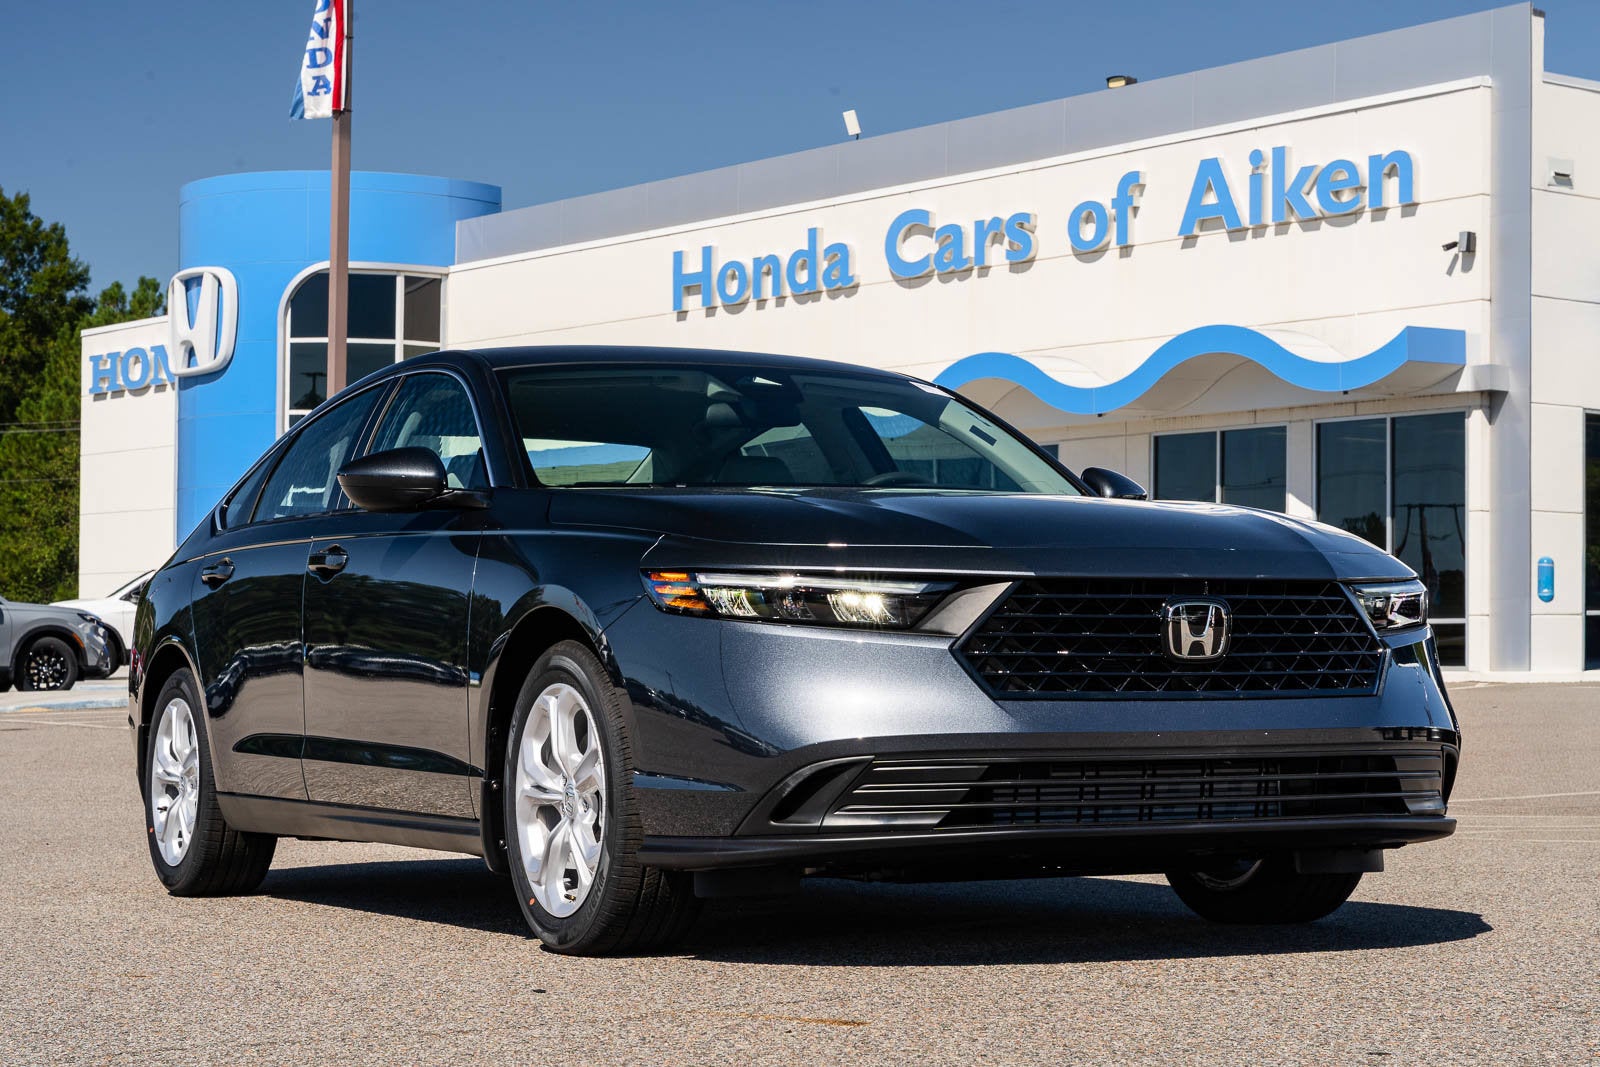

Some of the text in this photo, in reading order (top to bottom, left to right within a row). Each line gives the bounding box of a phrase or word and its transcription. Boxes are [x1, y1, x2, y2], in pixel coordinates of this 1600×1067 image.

[672, 145, 1415, 312] Honda Cars of Aiken
